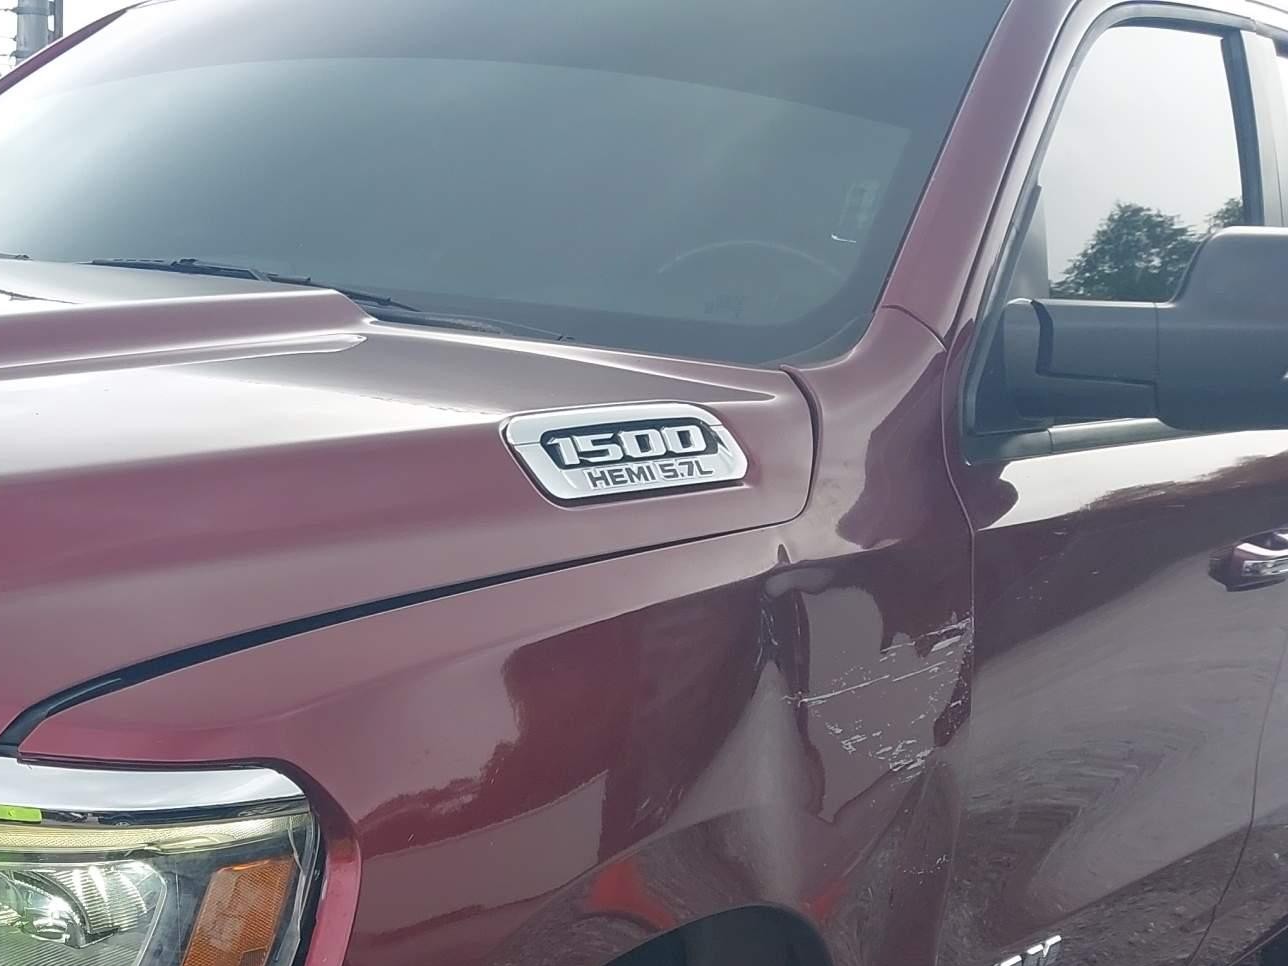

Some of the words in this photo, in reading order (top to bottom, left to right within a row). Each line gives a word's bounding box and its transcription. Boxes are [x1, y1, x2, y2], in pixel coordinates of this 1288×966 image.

[546, 424, 708, 467] 1500
[587, 465, 656, 489] HEMI
[661, 459, 713, 480] 5.7L
